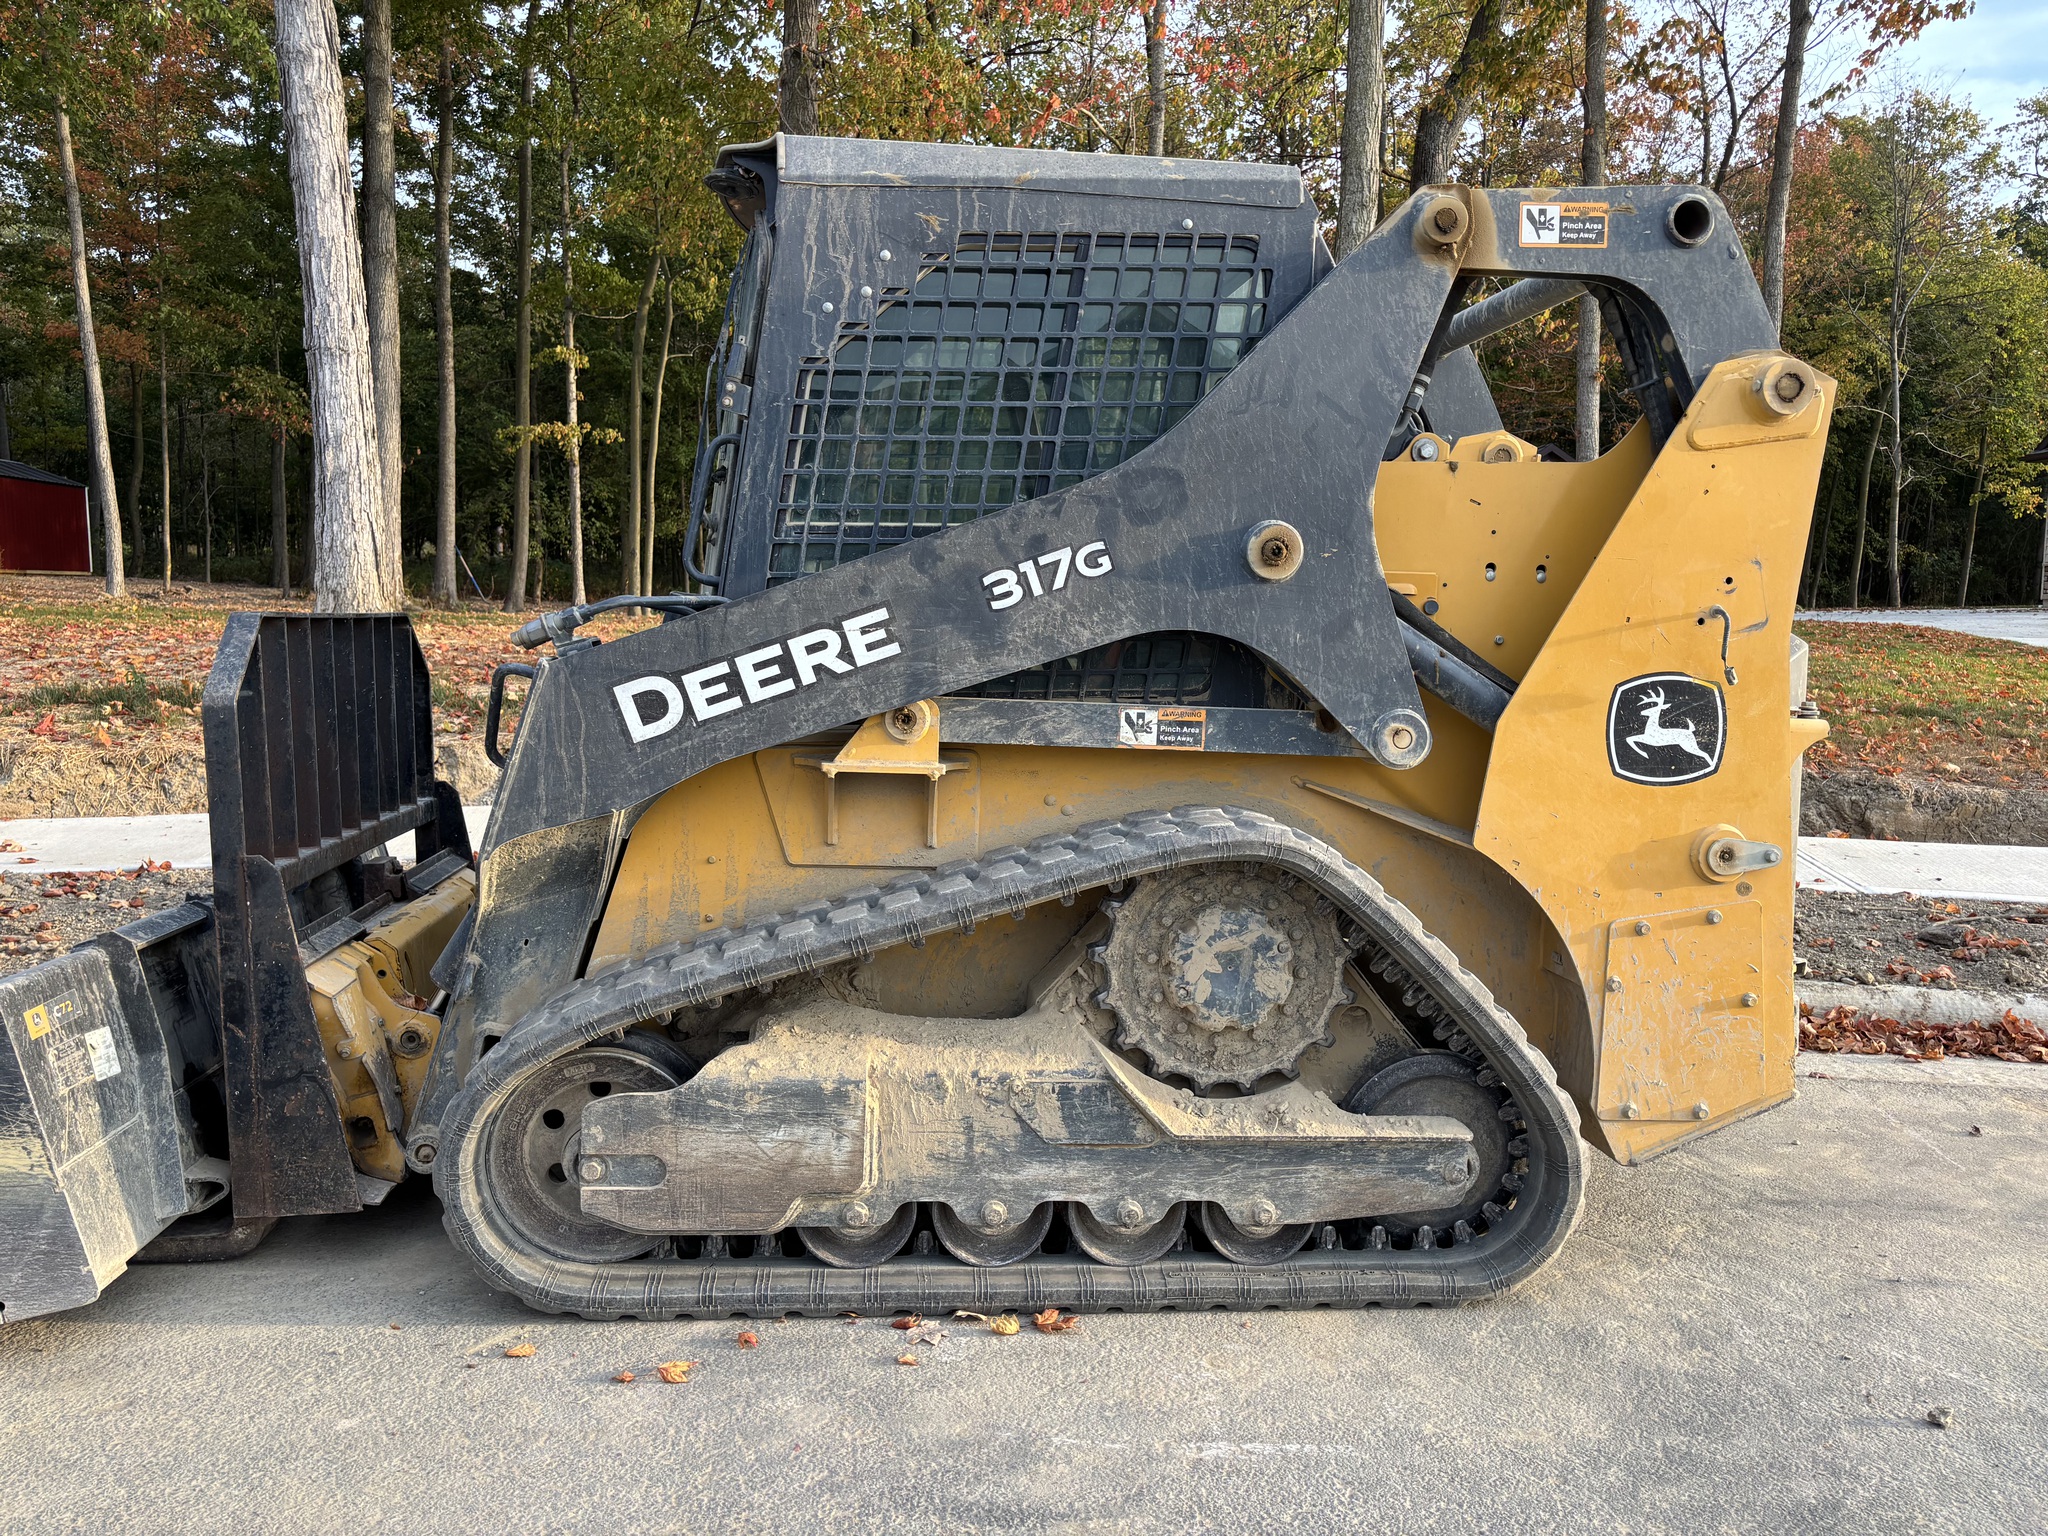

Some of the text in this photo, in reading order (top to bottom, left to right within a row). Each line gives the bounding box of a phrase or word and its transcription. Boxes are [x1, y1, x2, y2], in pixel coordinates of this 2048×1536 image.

[982, 541, 1113, 610] 317G
[613, 607, 902, 744] DEERE
[1160, 725, 1181, 733] Pinch
[53, 1000, 74, 1018] C72
